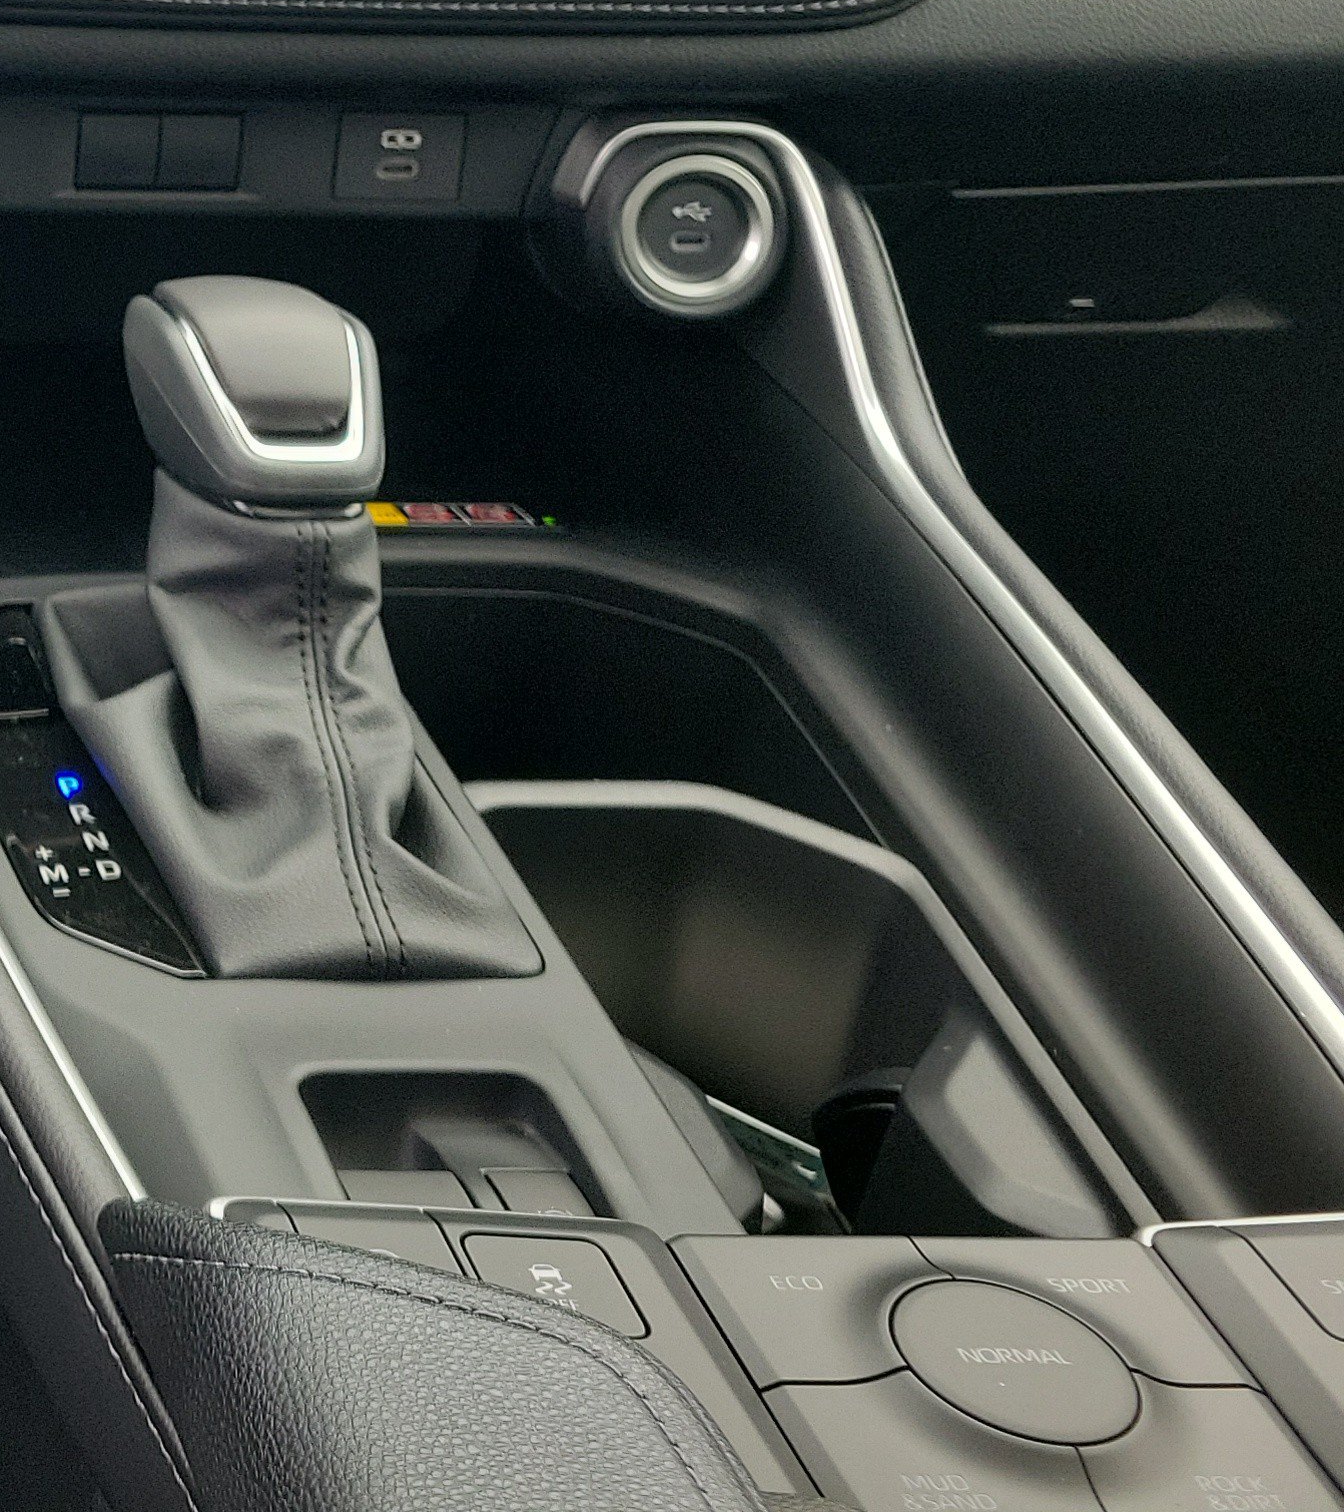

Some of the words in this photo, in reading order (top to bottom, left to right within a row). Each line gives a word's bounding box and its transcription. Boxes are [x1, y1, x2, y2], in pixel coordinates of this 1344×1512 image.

[57, 775, 81, 798] P
[68, 802, 96, 826] R
[82, 831, 110, 852] N
[38, 862, 70, 885] M
[94, 859, 122, 882] D
[769, 1274, 824, 1291] ECO
[1046, 1276, 1133, 1294] SPORT
[956, 1346, 1073, 1366] NORMAL
[900, 1473, 970, 1490] MUD
[1192, 1474, 1269, 1491] ROCK
